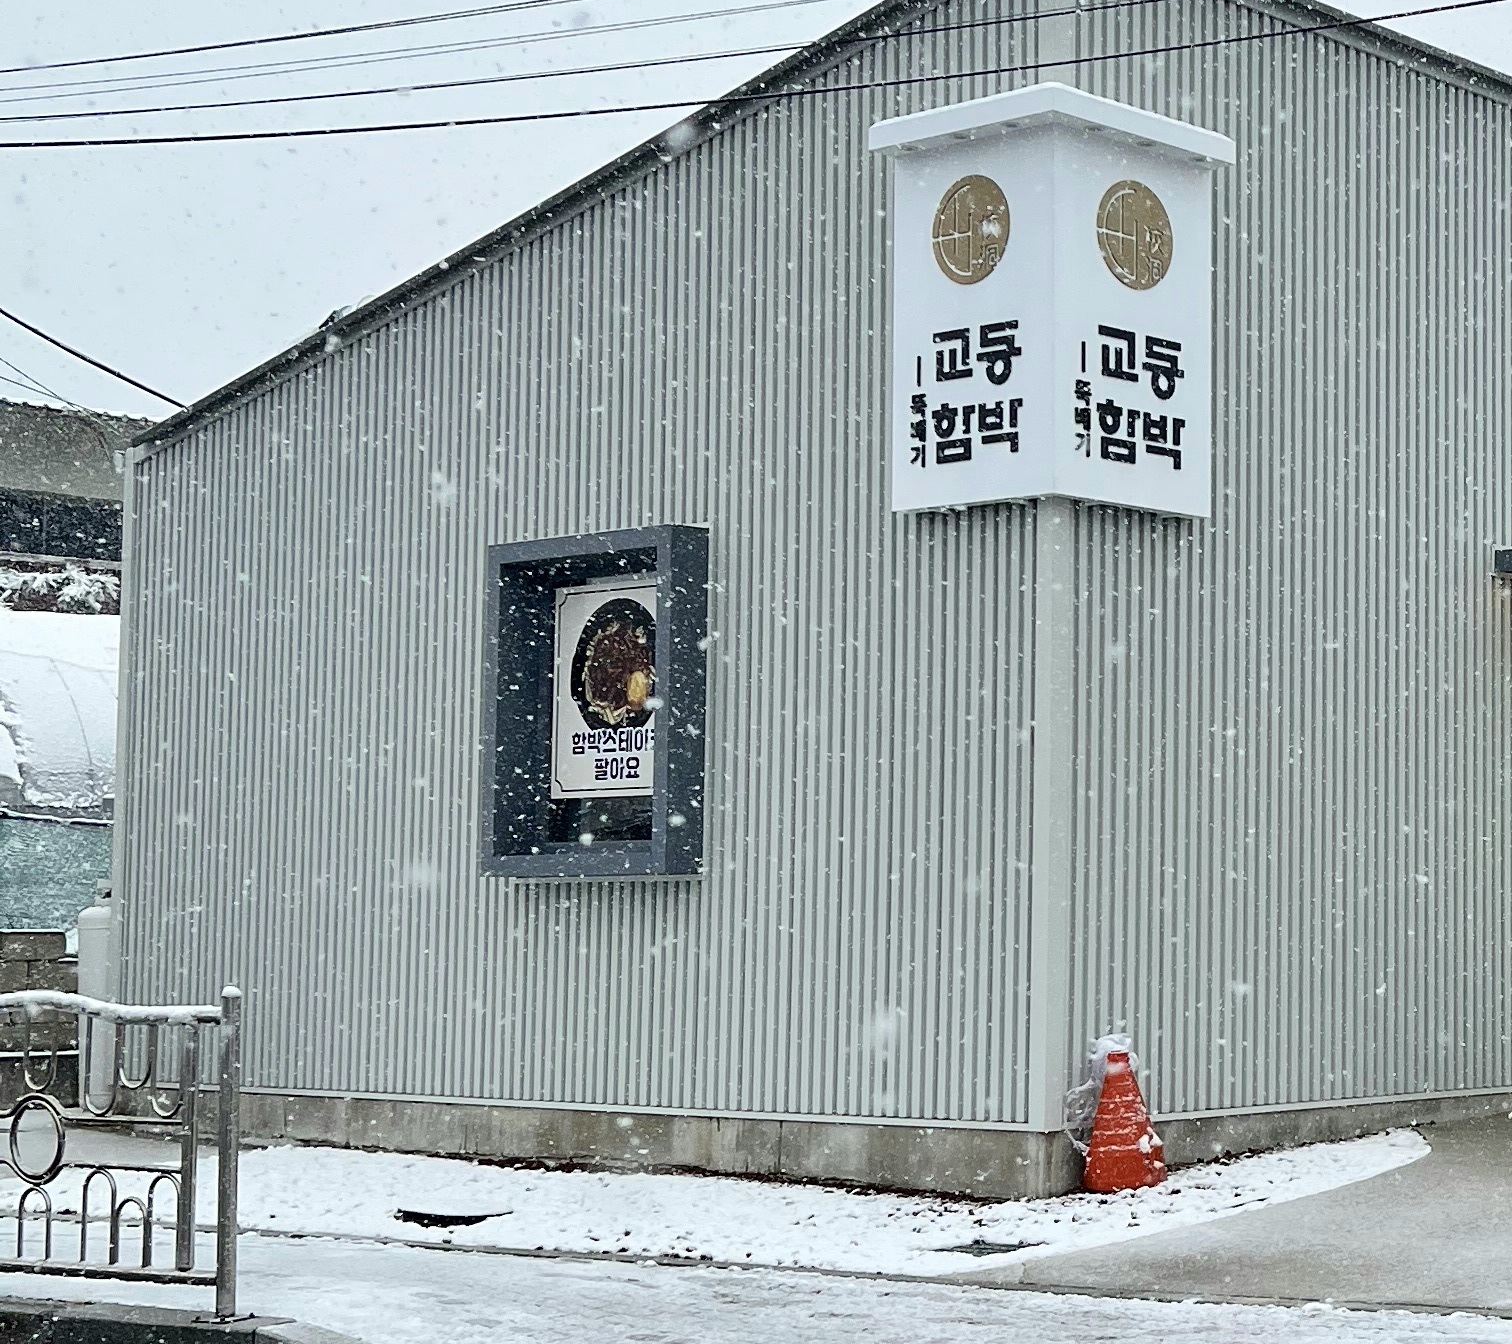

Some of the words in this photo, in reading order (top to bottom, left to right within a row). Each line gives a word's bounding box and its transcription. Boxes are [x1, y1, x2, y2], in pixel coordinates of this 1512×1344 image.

[932, 319, 1022, 385] 교동
[1098, 324, 1185, 400] 교동
[932, 398, 1024, 465] 함박
[1096, 398, 1186, 470] 함박
[572, 728, 654, 755] 함박스테이
[594, 756, 640, 780] 팔아요
